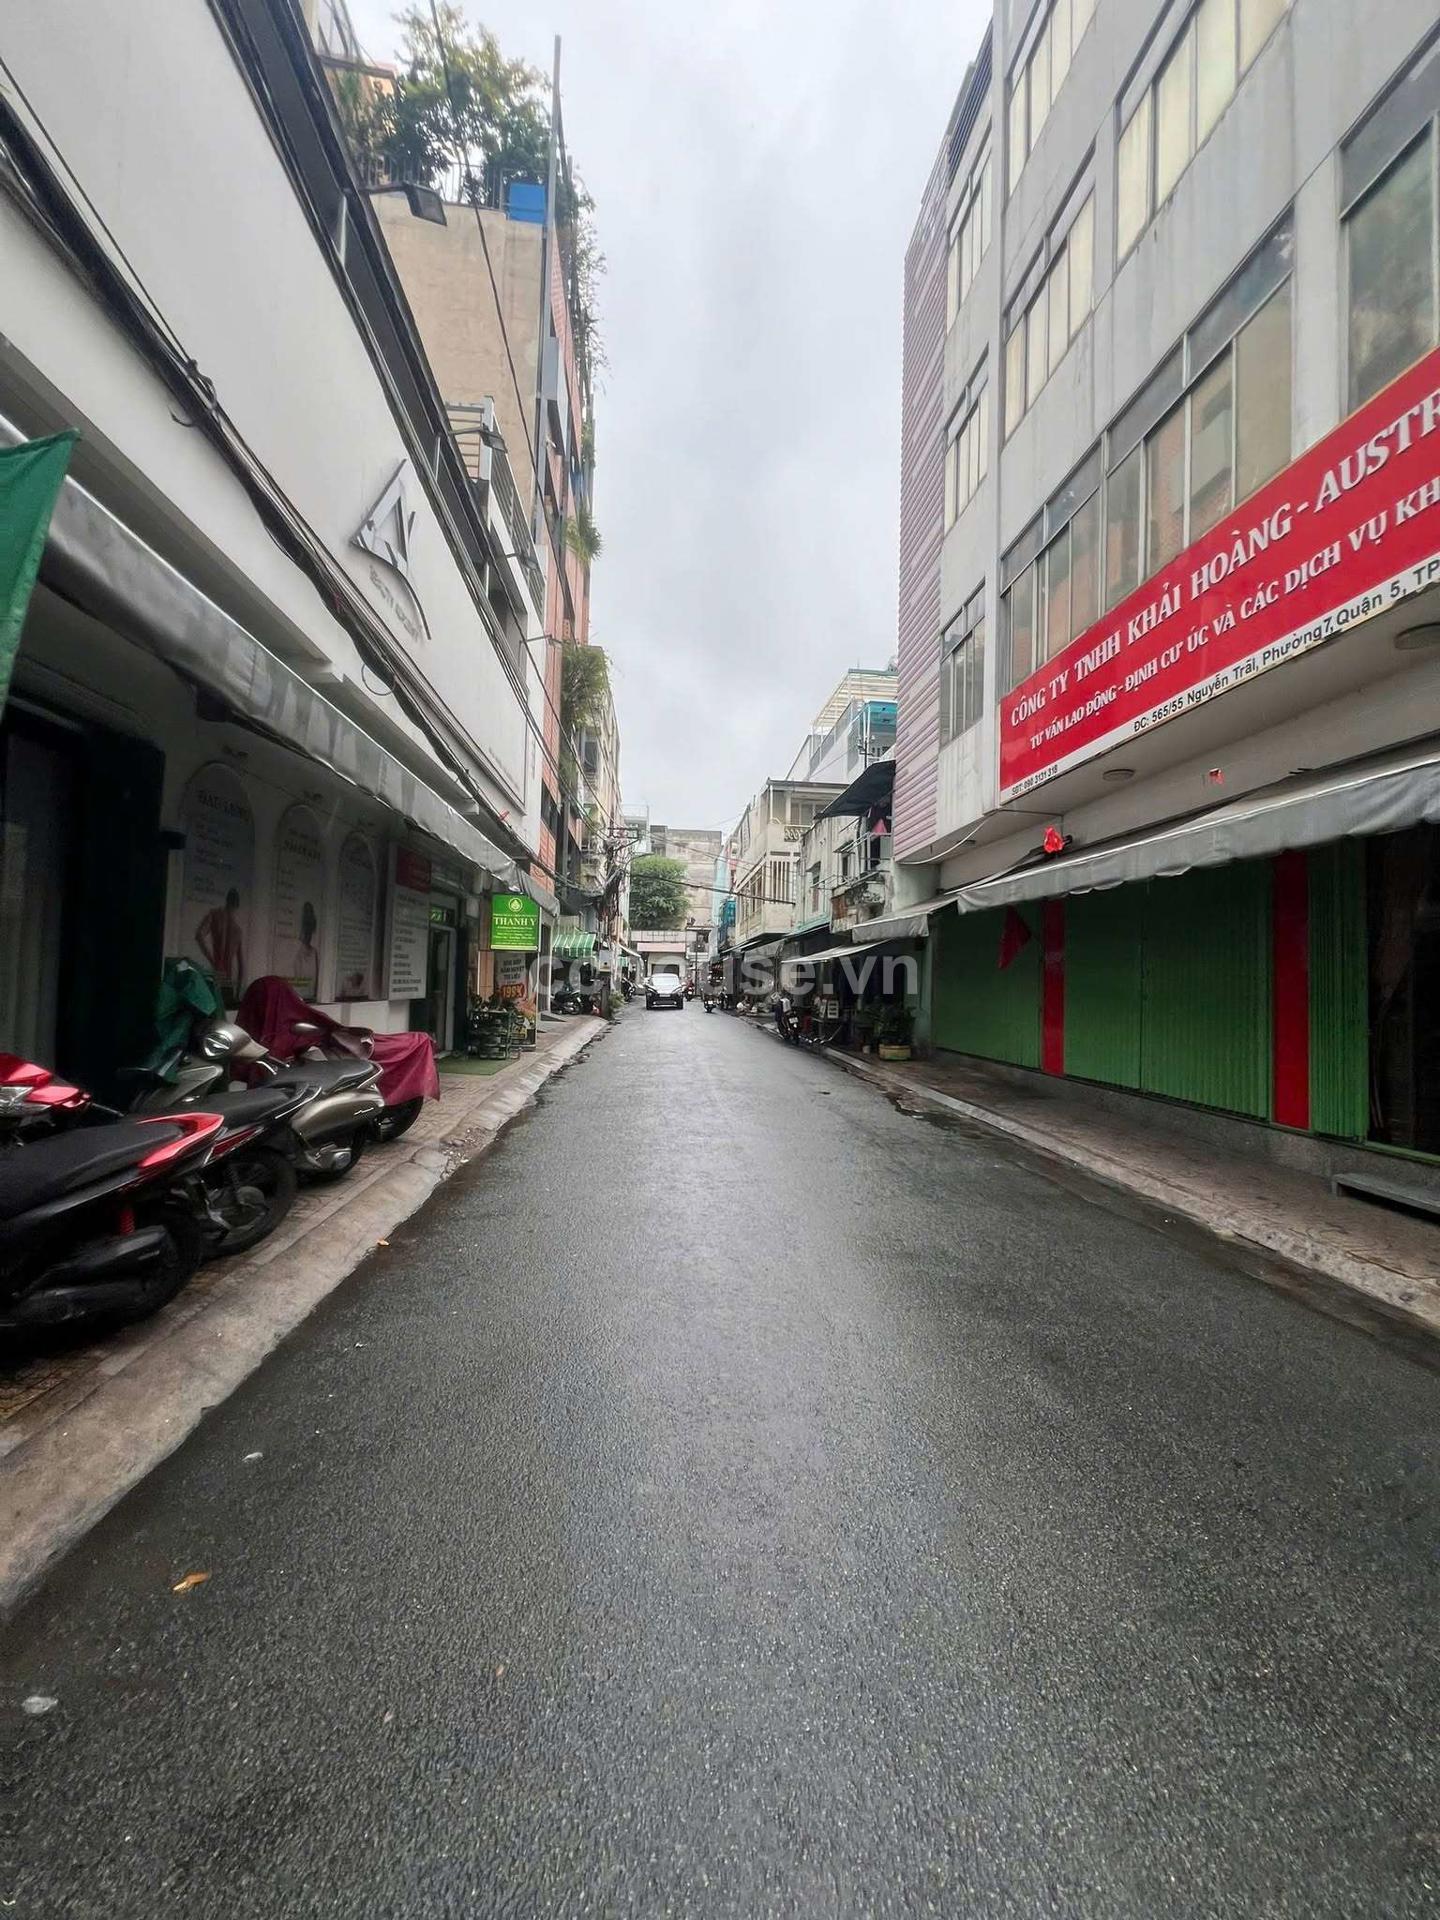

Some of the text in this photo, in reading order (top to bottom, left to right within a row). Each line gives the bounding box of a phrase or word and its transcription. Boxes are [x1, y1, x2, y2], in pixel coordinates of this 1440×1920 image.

[1011, 687, 1046, 727] CÔNG
[1049, 669, 1069, 700] TY
[1074, 630, 1121, 682] TNHH
[1127, 582, 1182, 646] KHẢI
[1190, 502, 1293, 600] HOÀNG
[1030, 734, 1045, 750] TƯ
[1044, 717, 1064, 741] VẤN
[1064, 706, 1085, 729] LAO
[1086, 684, 1117, 717] ĐỘNG
[1125, 657, 1158, 692] ĐỊNH
[1160, 640, 1184, 669] CƯ
[1187, 625, 1209, 652] ÚC
[1212, 603, 1236, 636] VÀ
[1240, 580, 1279, 619] CÁC
[1284, 541, 1341, 595] DỊCH
[1348, 510, 1388, 552] VỤ
[1395, 476, 1440, 526] KH
[1134, 716, 1149, 732] ĐC:
[1152, 697, 1184, 722] 565/55
[1187, 674, 1229, 705] Nguyễn
[1233, 658, 1259, 680] Trãi,
[1390, 579, 1407, 597] 5,
[493, 916, 528, 926] THANH
